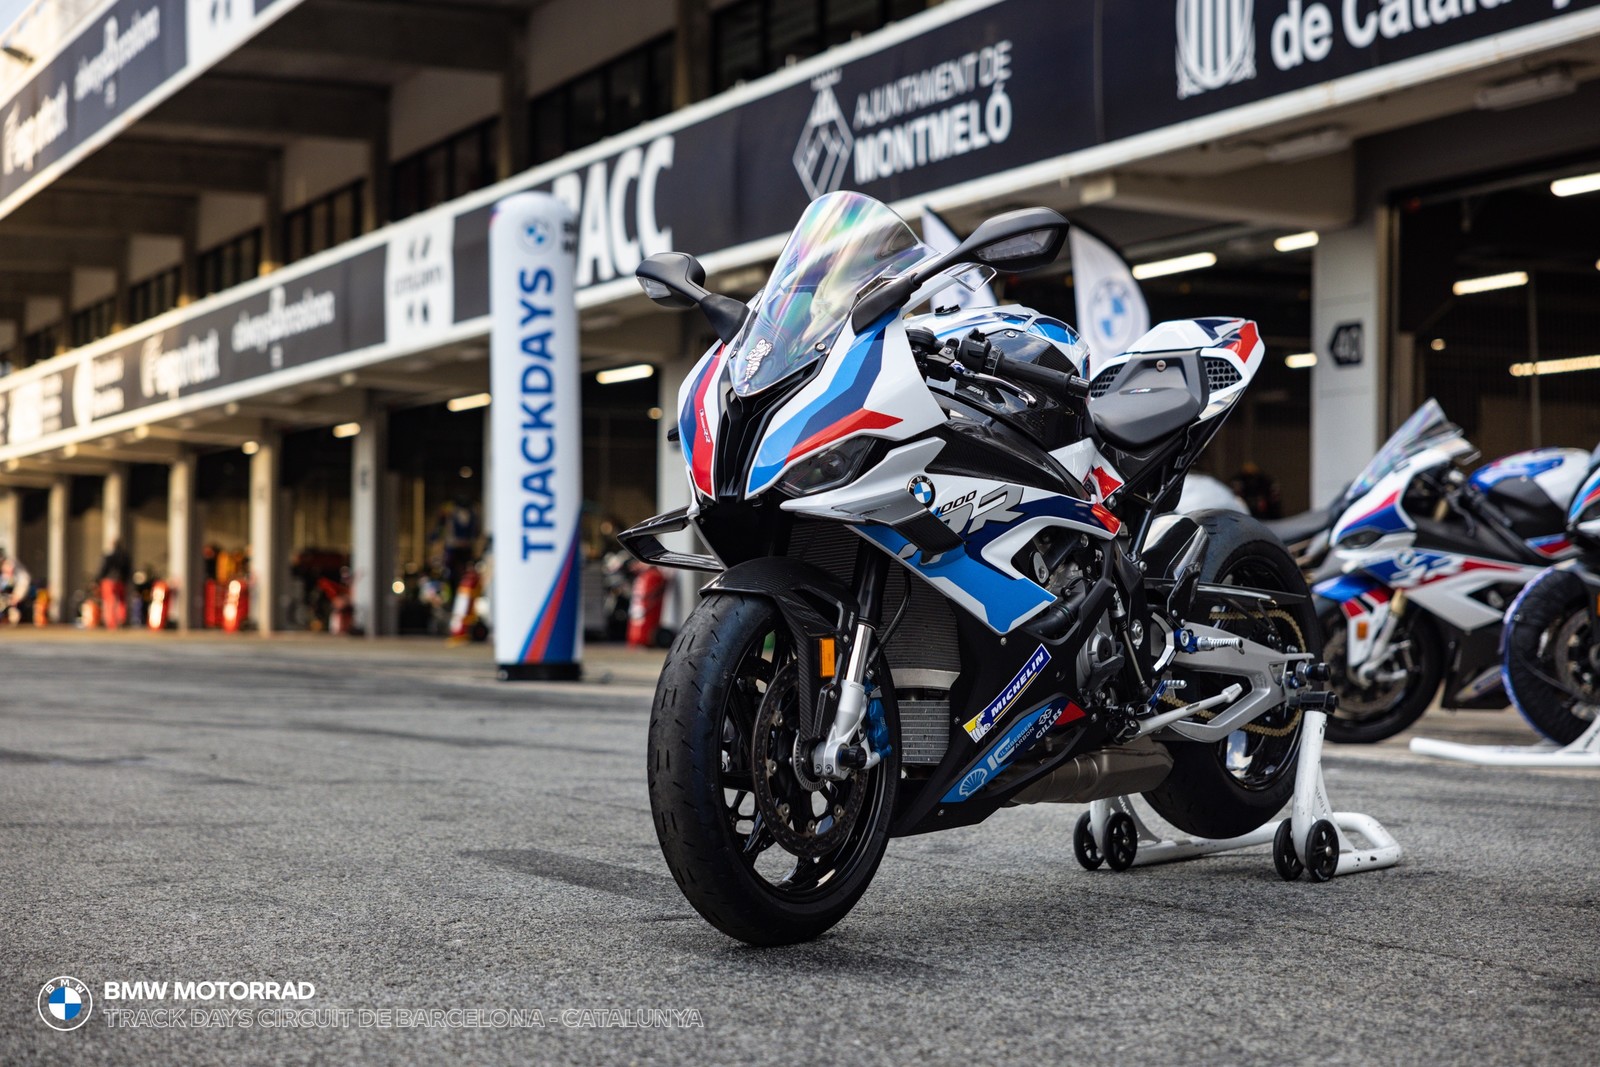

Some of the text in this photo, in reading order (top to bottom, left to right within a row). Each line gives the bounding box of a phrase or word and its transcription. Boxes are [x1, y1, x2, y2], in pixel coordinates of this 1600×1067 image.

[1270, 0, 1333, 71] de
[853, 40, 1012, 131] AJUNTAMENT DE
[854, 82, 1012, 185] MONTMELÓ
[520, 267, 556, 562] TRACKDAYS
[990, 652, 1045, 718] MICHELIN
[1000, 722, 1033, 757] ILMBERGER
[1036, 708, 1063, 739] GILLES
